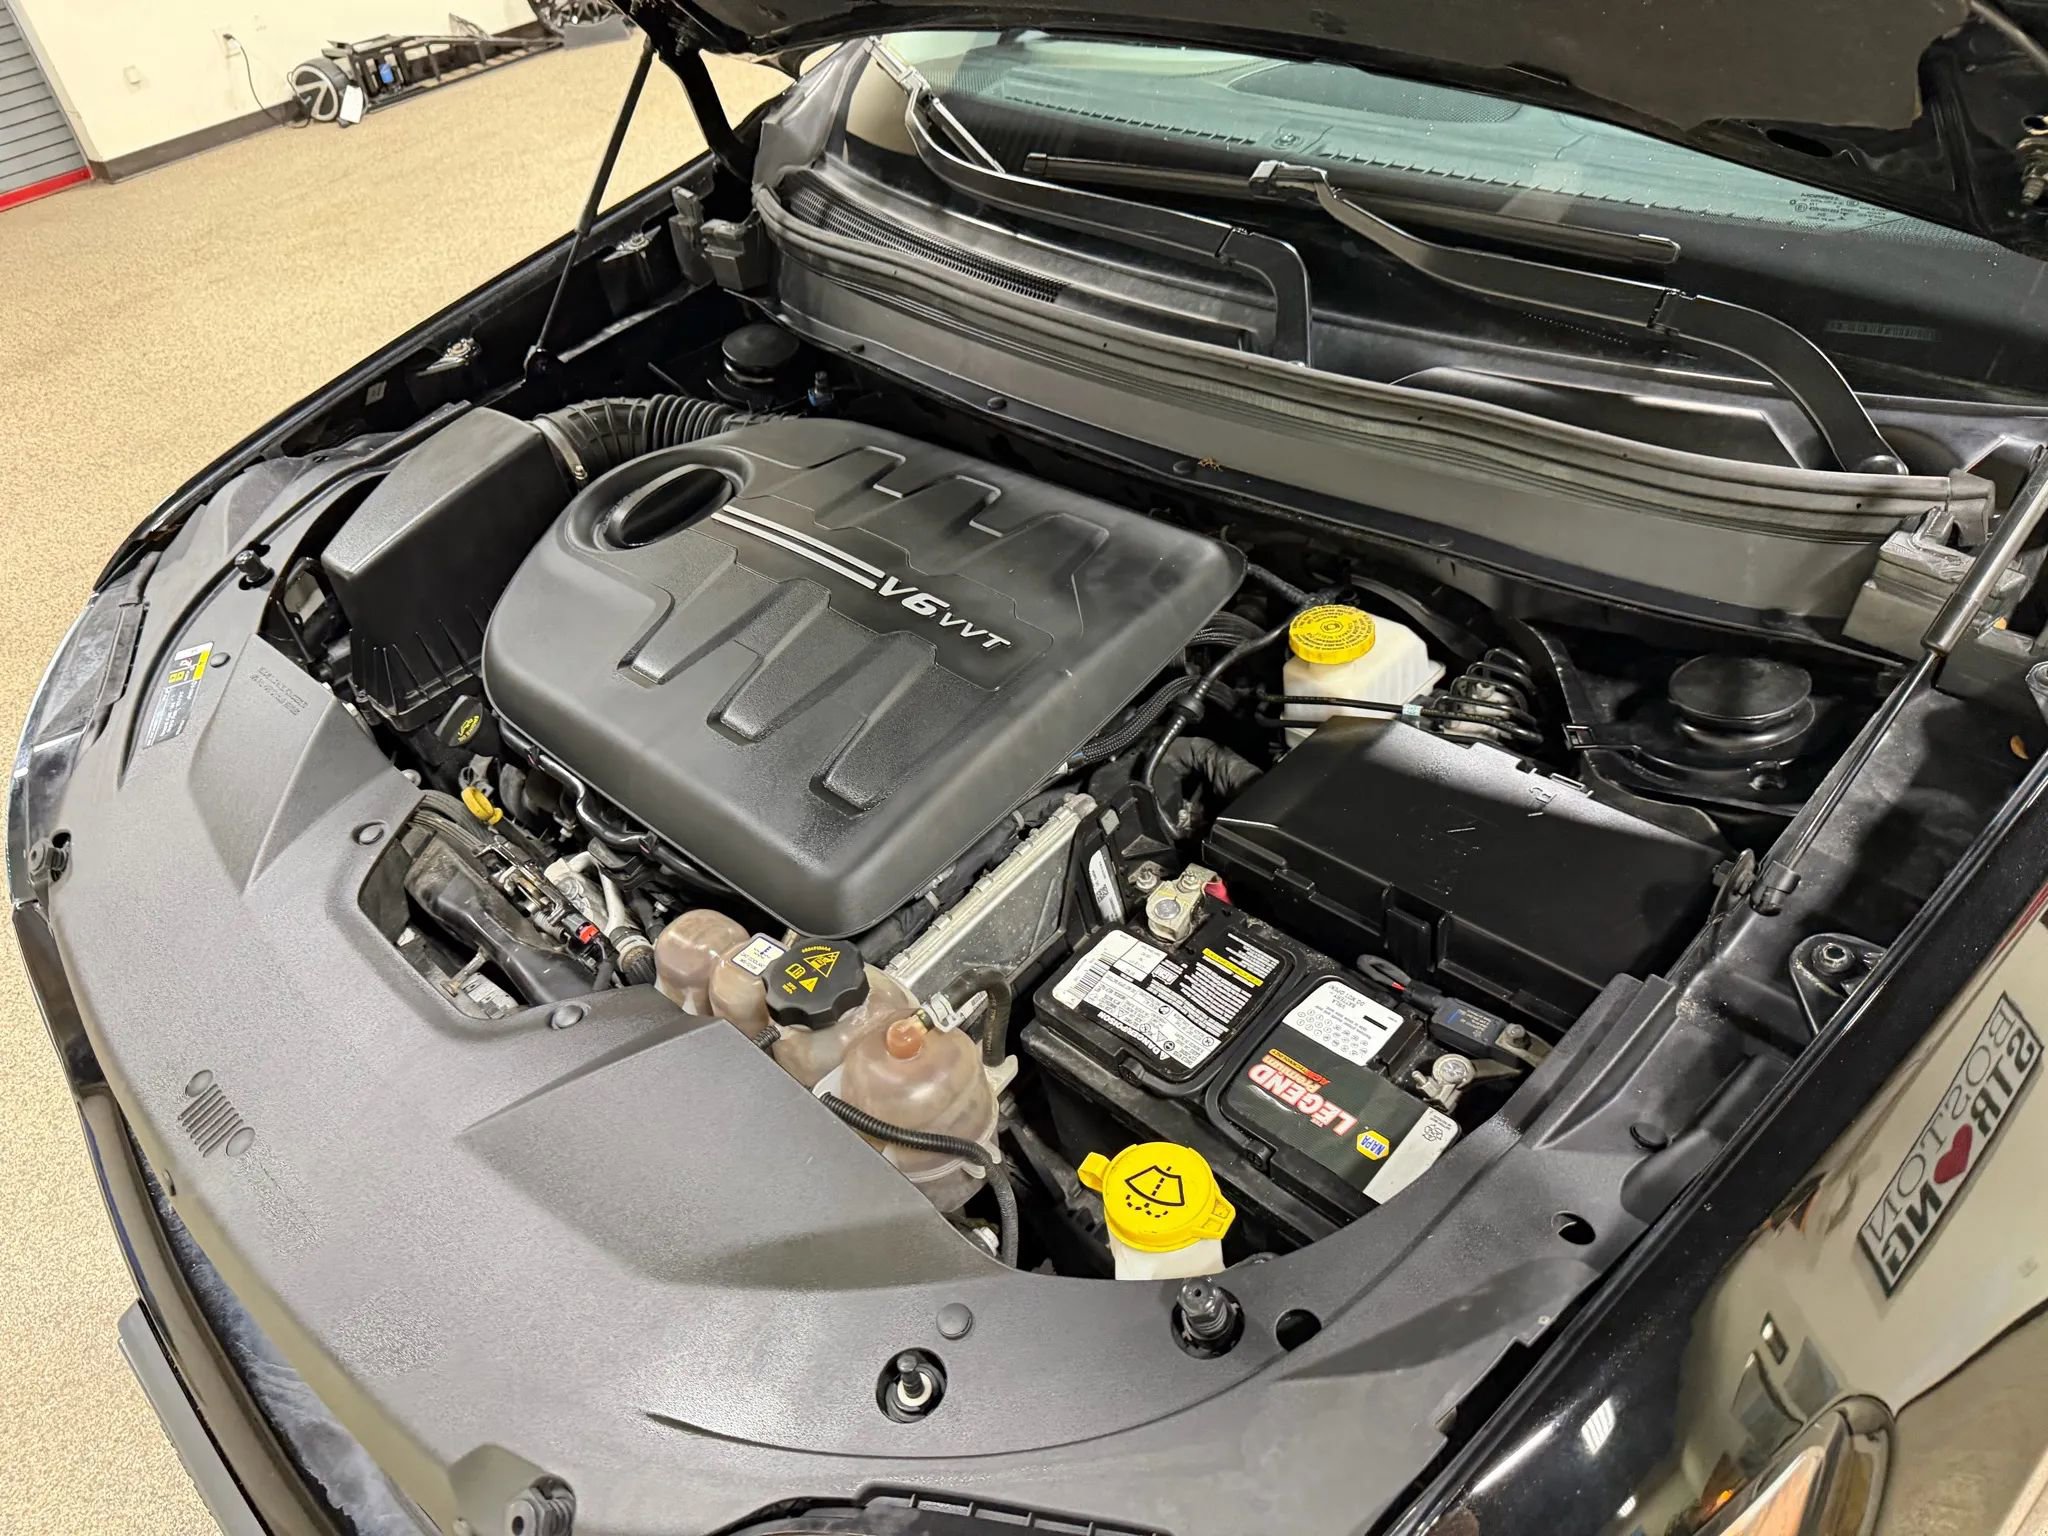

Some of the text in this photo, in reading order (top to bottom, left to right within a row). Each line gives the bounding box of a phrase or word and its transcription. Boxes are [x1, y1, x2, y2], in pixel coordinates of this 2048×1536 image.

[878, 576, 1011, 648] V6 VVT
[1249, 1063, 1358, 1137] LEGEND
[1262, 1054, 1322, 1093] Premium
[1360, 1135, 1386, 1156] NAPA
